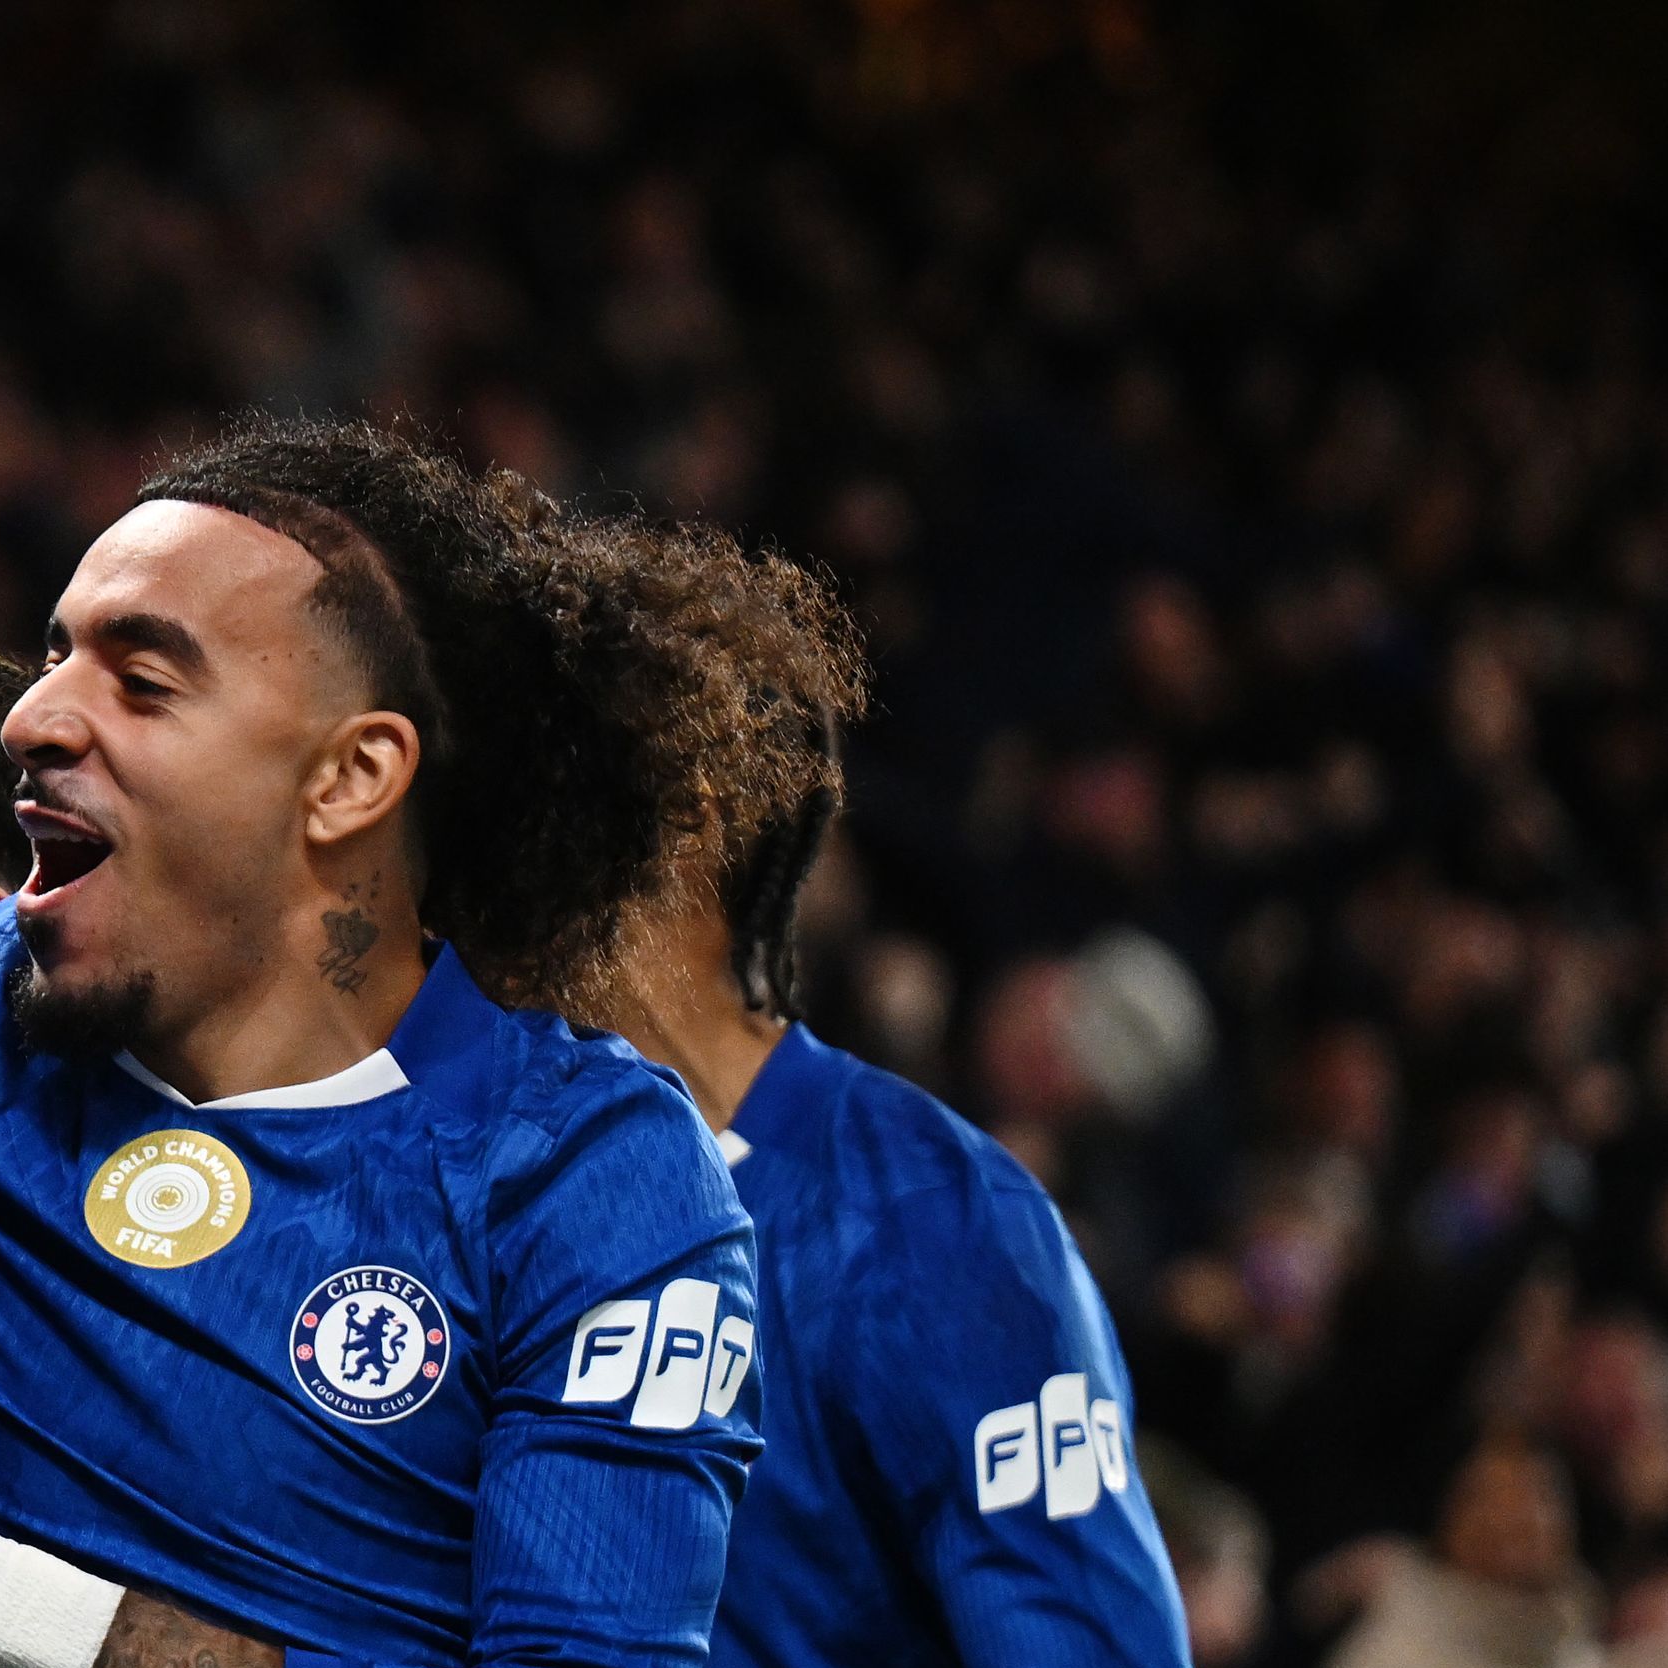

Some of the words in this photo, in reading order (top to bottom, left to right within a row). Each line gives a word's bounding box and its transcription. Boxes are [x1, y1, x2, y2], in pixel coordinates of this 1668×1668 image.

[100, 1145, 159, 1200] WORLD
[164, 1140, 236, 1228] CHAMPIONS
[115, 1226, 174, 1259] FIFA
[327, 1271, 426, 1313] CHELSEA
[310, 1378, 374, 1415] FOOTBALL
[380, 1391, 415, 1413] CLUB
